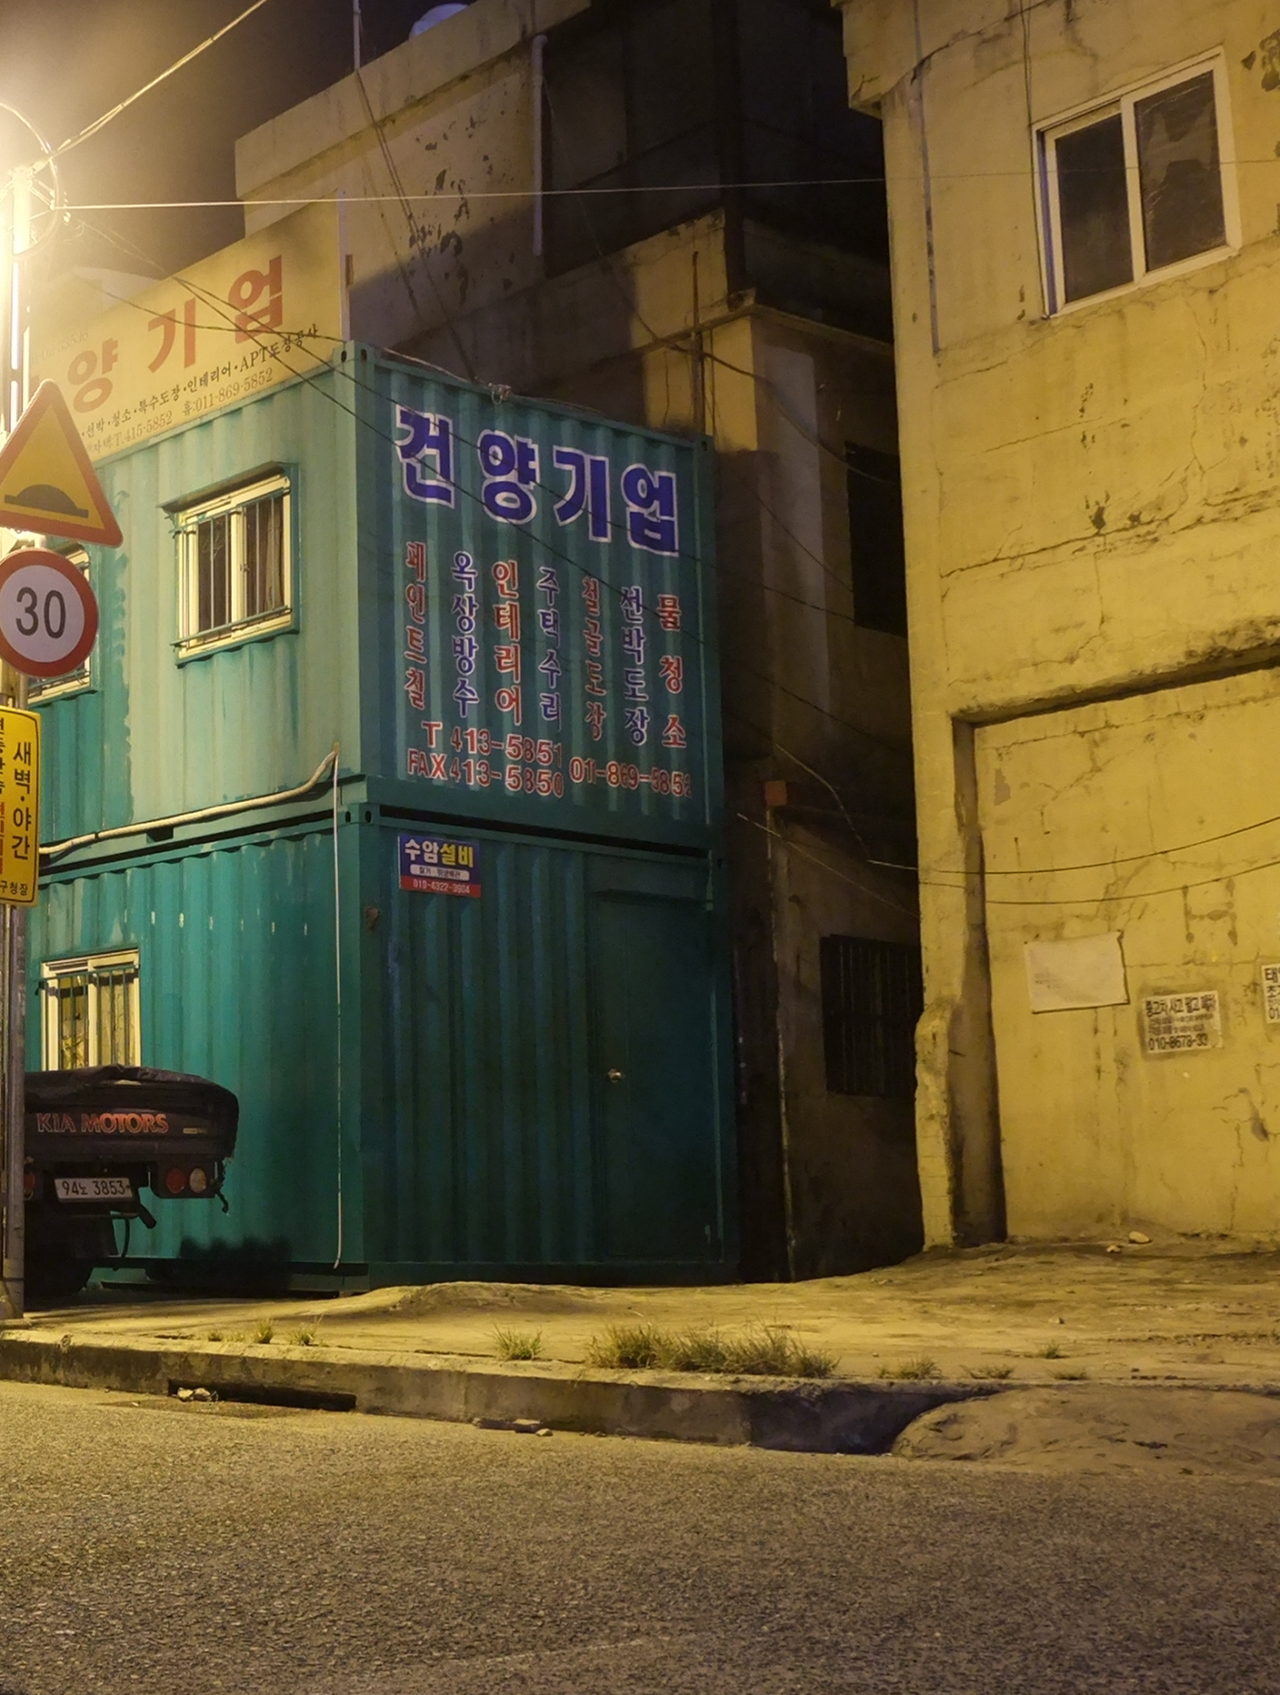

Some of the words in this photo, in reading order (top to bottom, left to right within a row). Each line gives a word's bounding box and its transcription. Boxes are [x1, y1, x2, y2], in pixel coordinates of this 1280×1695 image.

[396, 404, 679, 557] 건양기업
[16, 587, 66, 639] 30
[451, 551, 480, 719] 옥상방수
[492, 559, 522, 726] 인테리어
[537, 566, 562, 732] 주택수리
[422, 721, 442, 748] T
[407, 749, 448, 781] FAX
[37, 1113, 77, 1133] KIA
[81, 1113, 169, 1134] MOTORS
[92, 1180, 126, 1196] 3853
